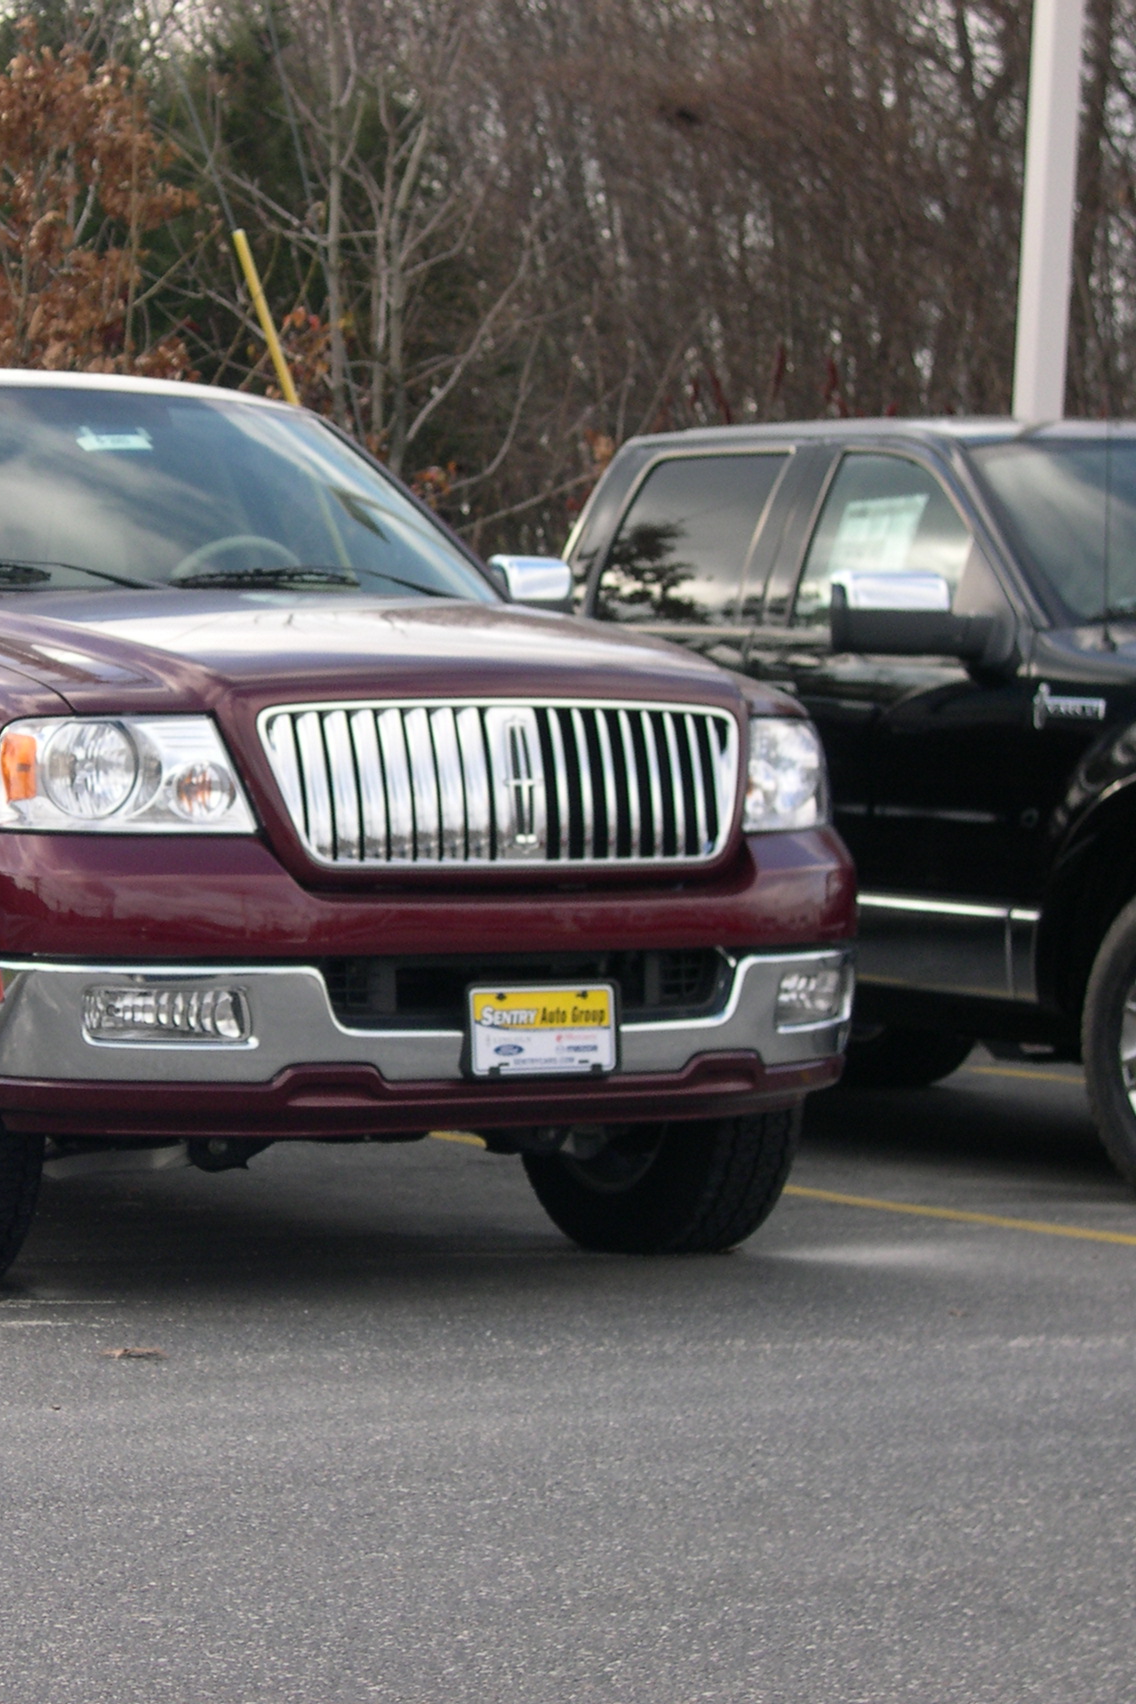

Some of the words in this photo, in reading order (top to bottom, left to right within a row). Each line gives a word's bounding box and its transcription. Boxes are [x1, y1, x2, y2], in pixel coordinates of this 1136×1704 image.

[481, 1006, 537, 1026] SENTRY
[540, 1007, 567, 1024] Auto
[571, 1006, 605, 1025] Group
